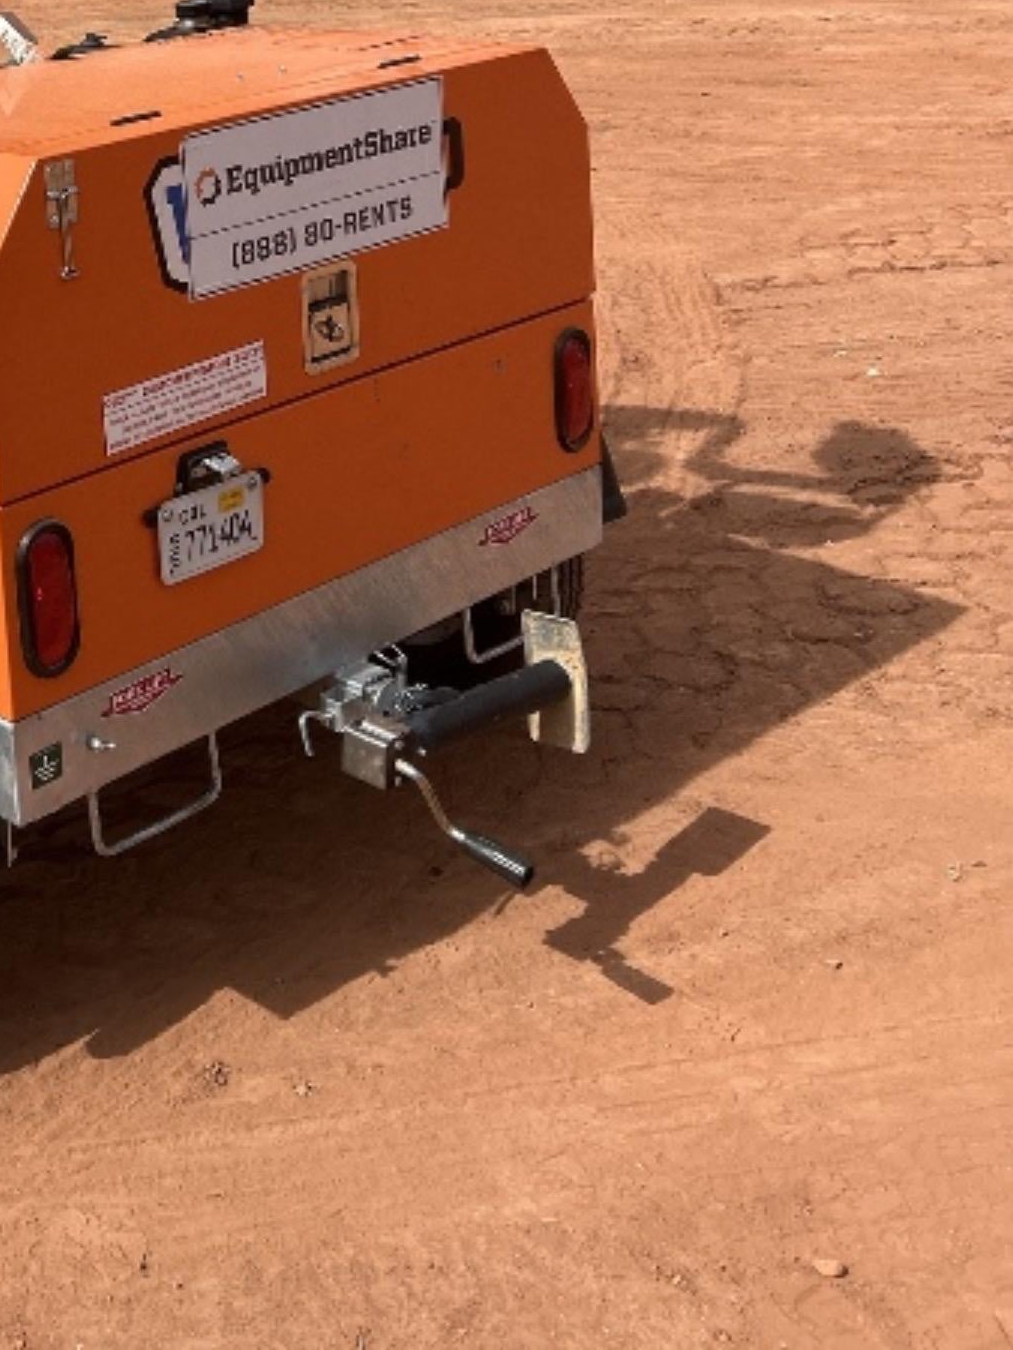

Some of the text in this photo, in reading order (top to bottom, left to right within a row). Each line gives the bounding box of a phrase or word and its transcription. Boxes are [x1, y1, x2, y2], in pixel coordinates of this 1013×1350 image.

[225, 123, 433, 196] EquipmentShare
[232, 194, 415, 268] (888) 80-RENTS
